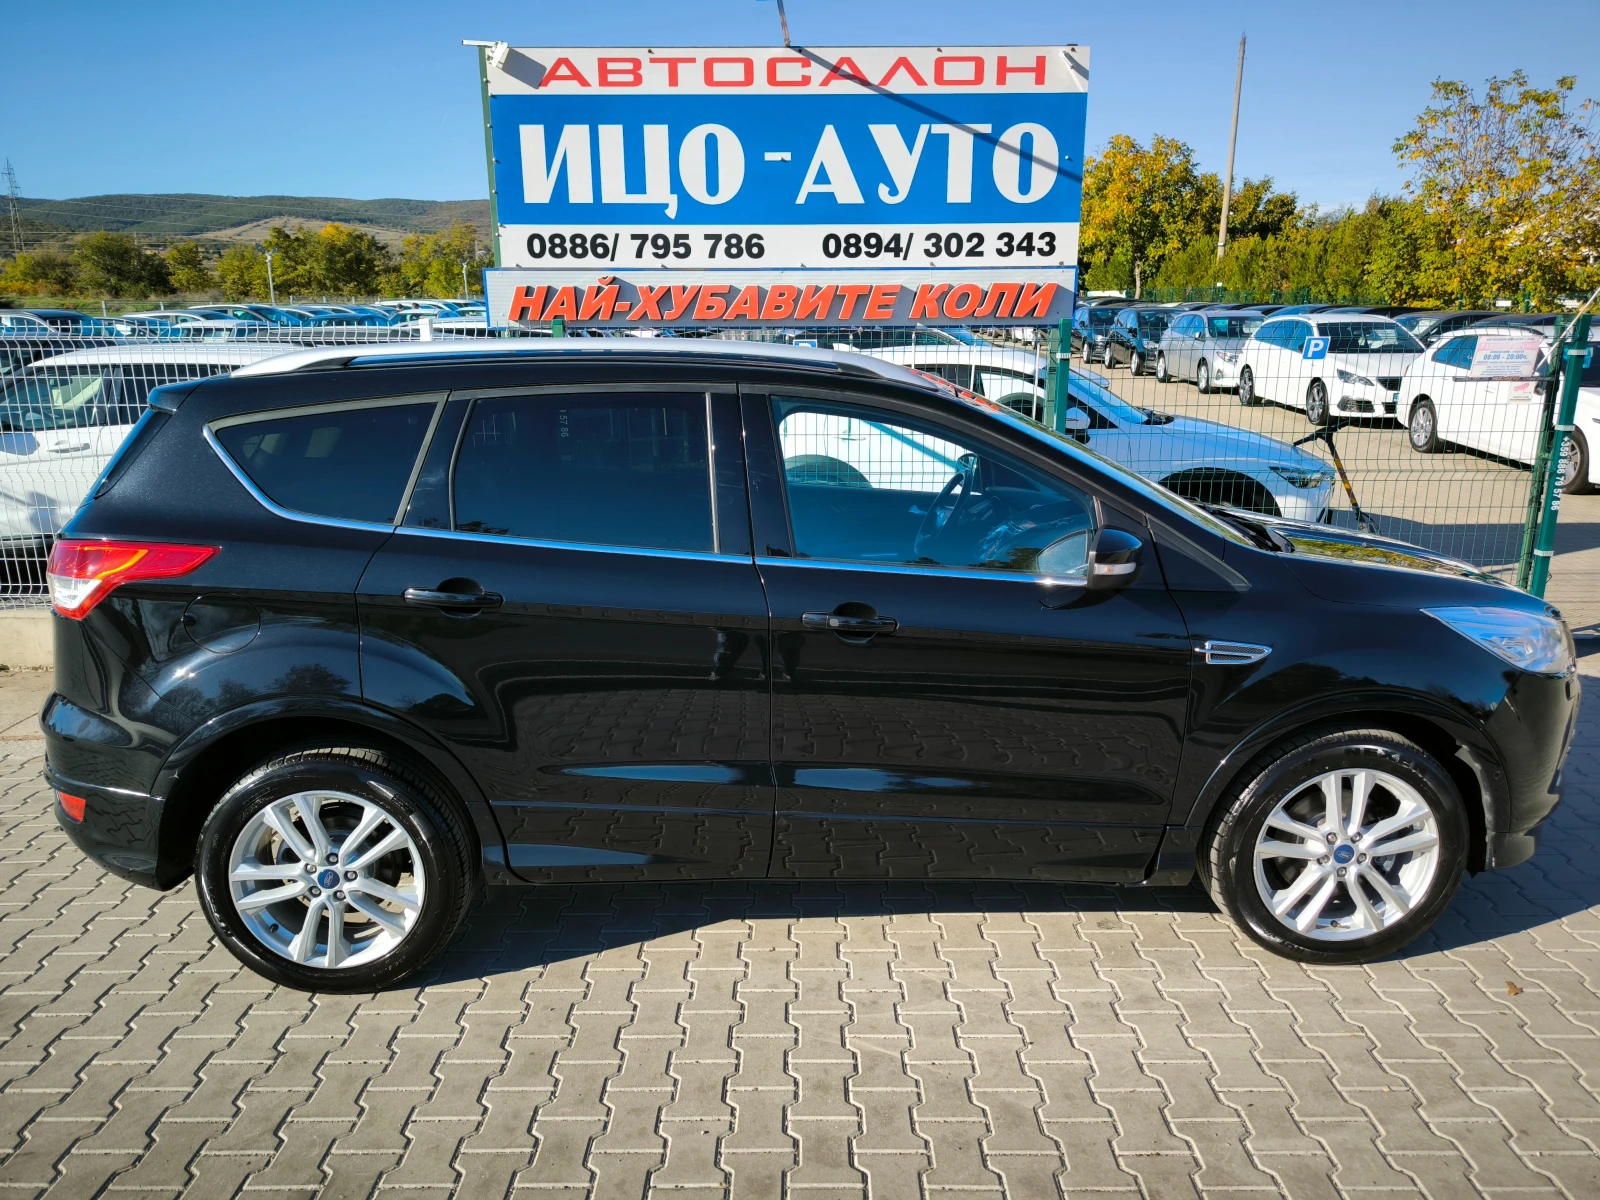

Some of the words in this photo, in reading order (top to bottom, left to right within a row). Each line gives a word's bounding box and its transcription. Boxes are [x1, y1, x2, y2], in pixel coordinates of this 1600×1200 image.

[540, 56, 1047, 88] АВТОСАЛОН
[526, 233, 620, 262] 0886/
[630, 233, 692, 259] 795
[703, 233, 765, 259] 786
[822, 233, 914, 261] 0894/
[923, 232, 985, 258] 302
[995, 231, 1057, 257] 343
[507, 275, 901, 321] НАЙ-ХУБАВИТЕ
[908, 282, 1058, 319] КОЛИ
[1307, 340, 1324, 358] P
[1559, 436, 1570, 457] +359
[1556, 459, 1567, 474] 886
[1554, 476, 1564, 486] 79
[1553, 488, 1562, 498] 57
[1550, 500, 1560, 511] 86
